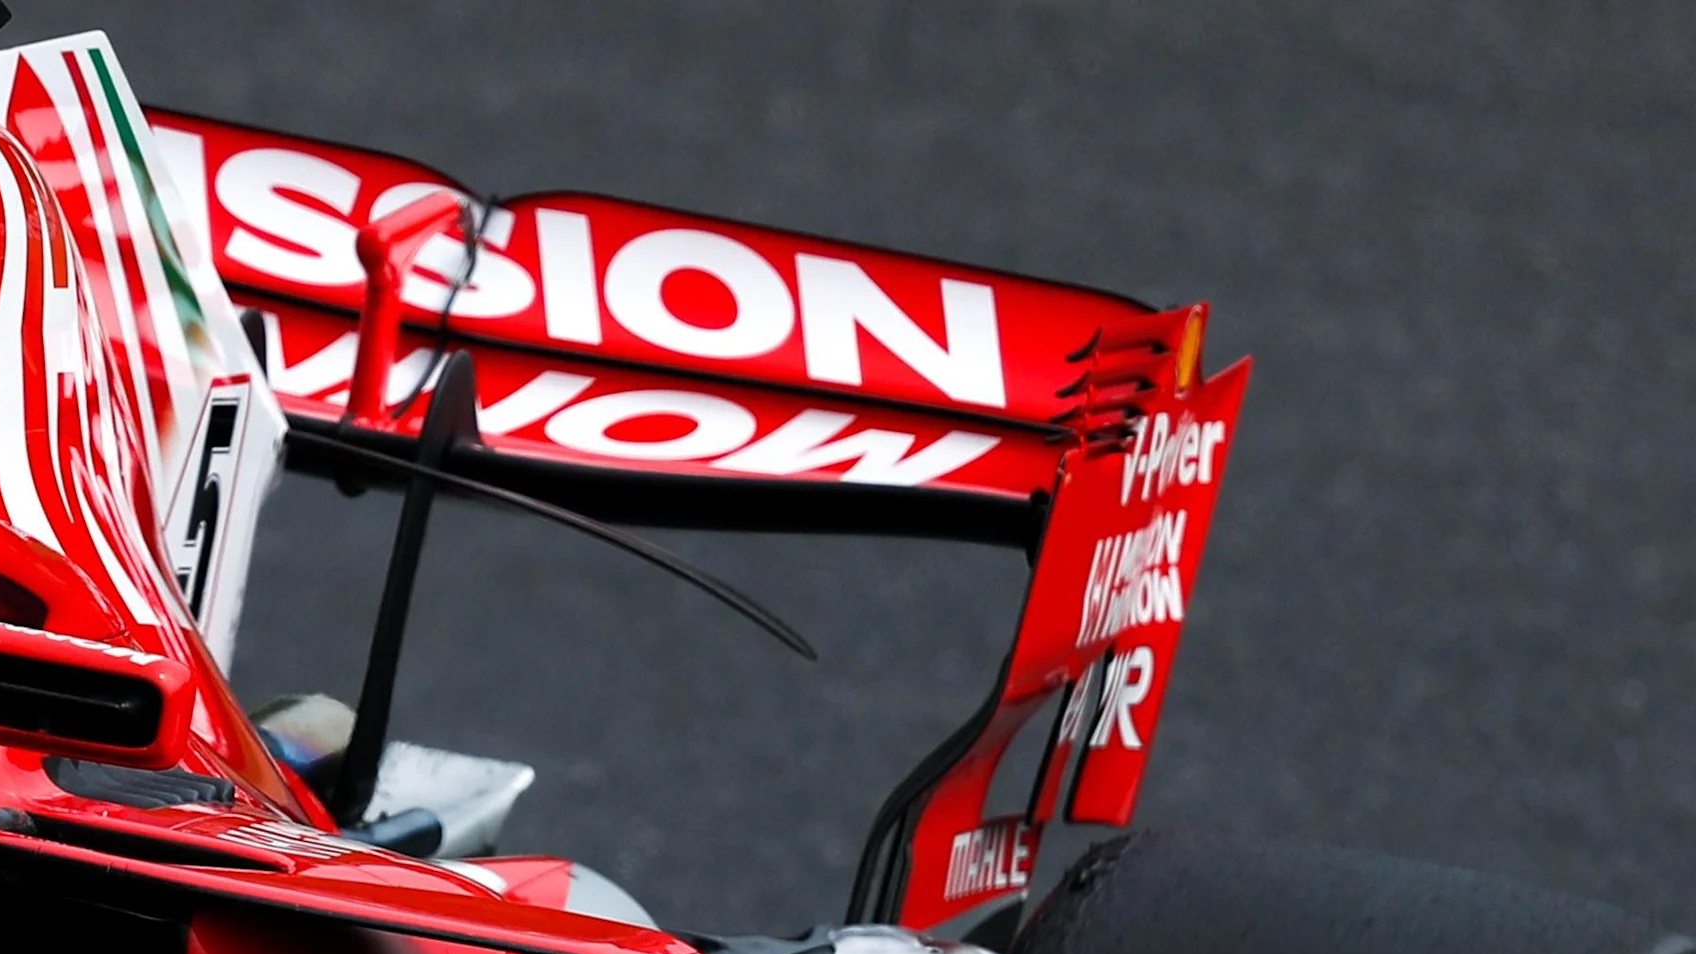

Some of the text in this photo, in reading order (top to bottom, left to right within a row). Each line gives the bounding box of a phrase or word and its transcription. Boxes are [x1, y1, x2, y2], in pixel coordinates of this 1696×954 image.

[152, 125, 1006, 409] ISSION
[177, 398, 241, 624] 5
[943, 822, 1030, 901] MAHLE
